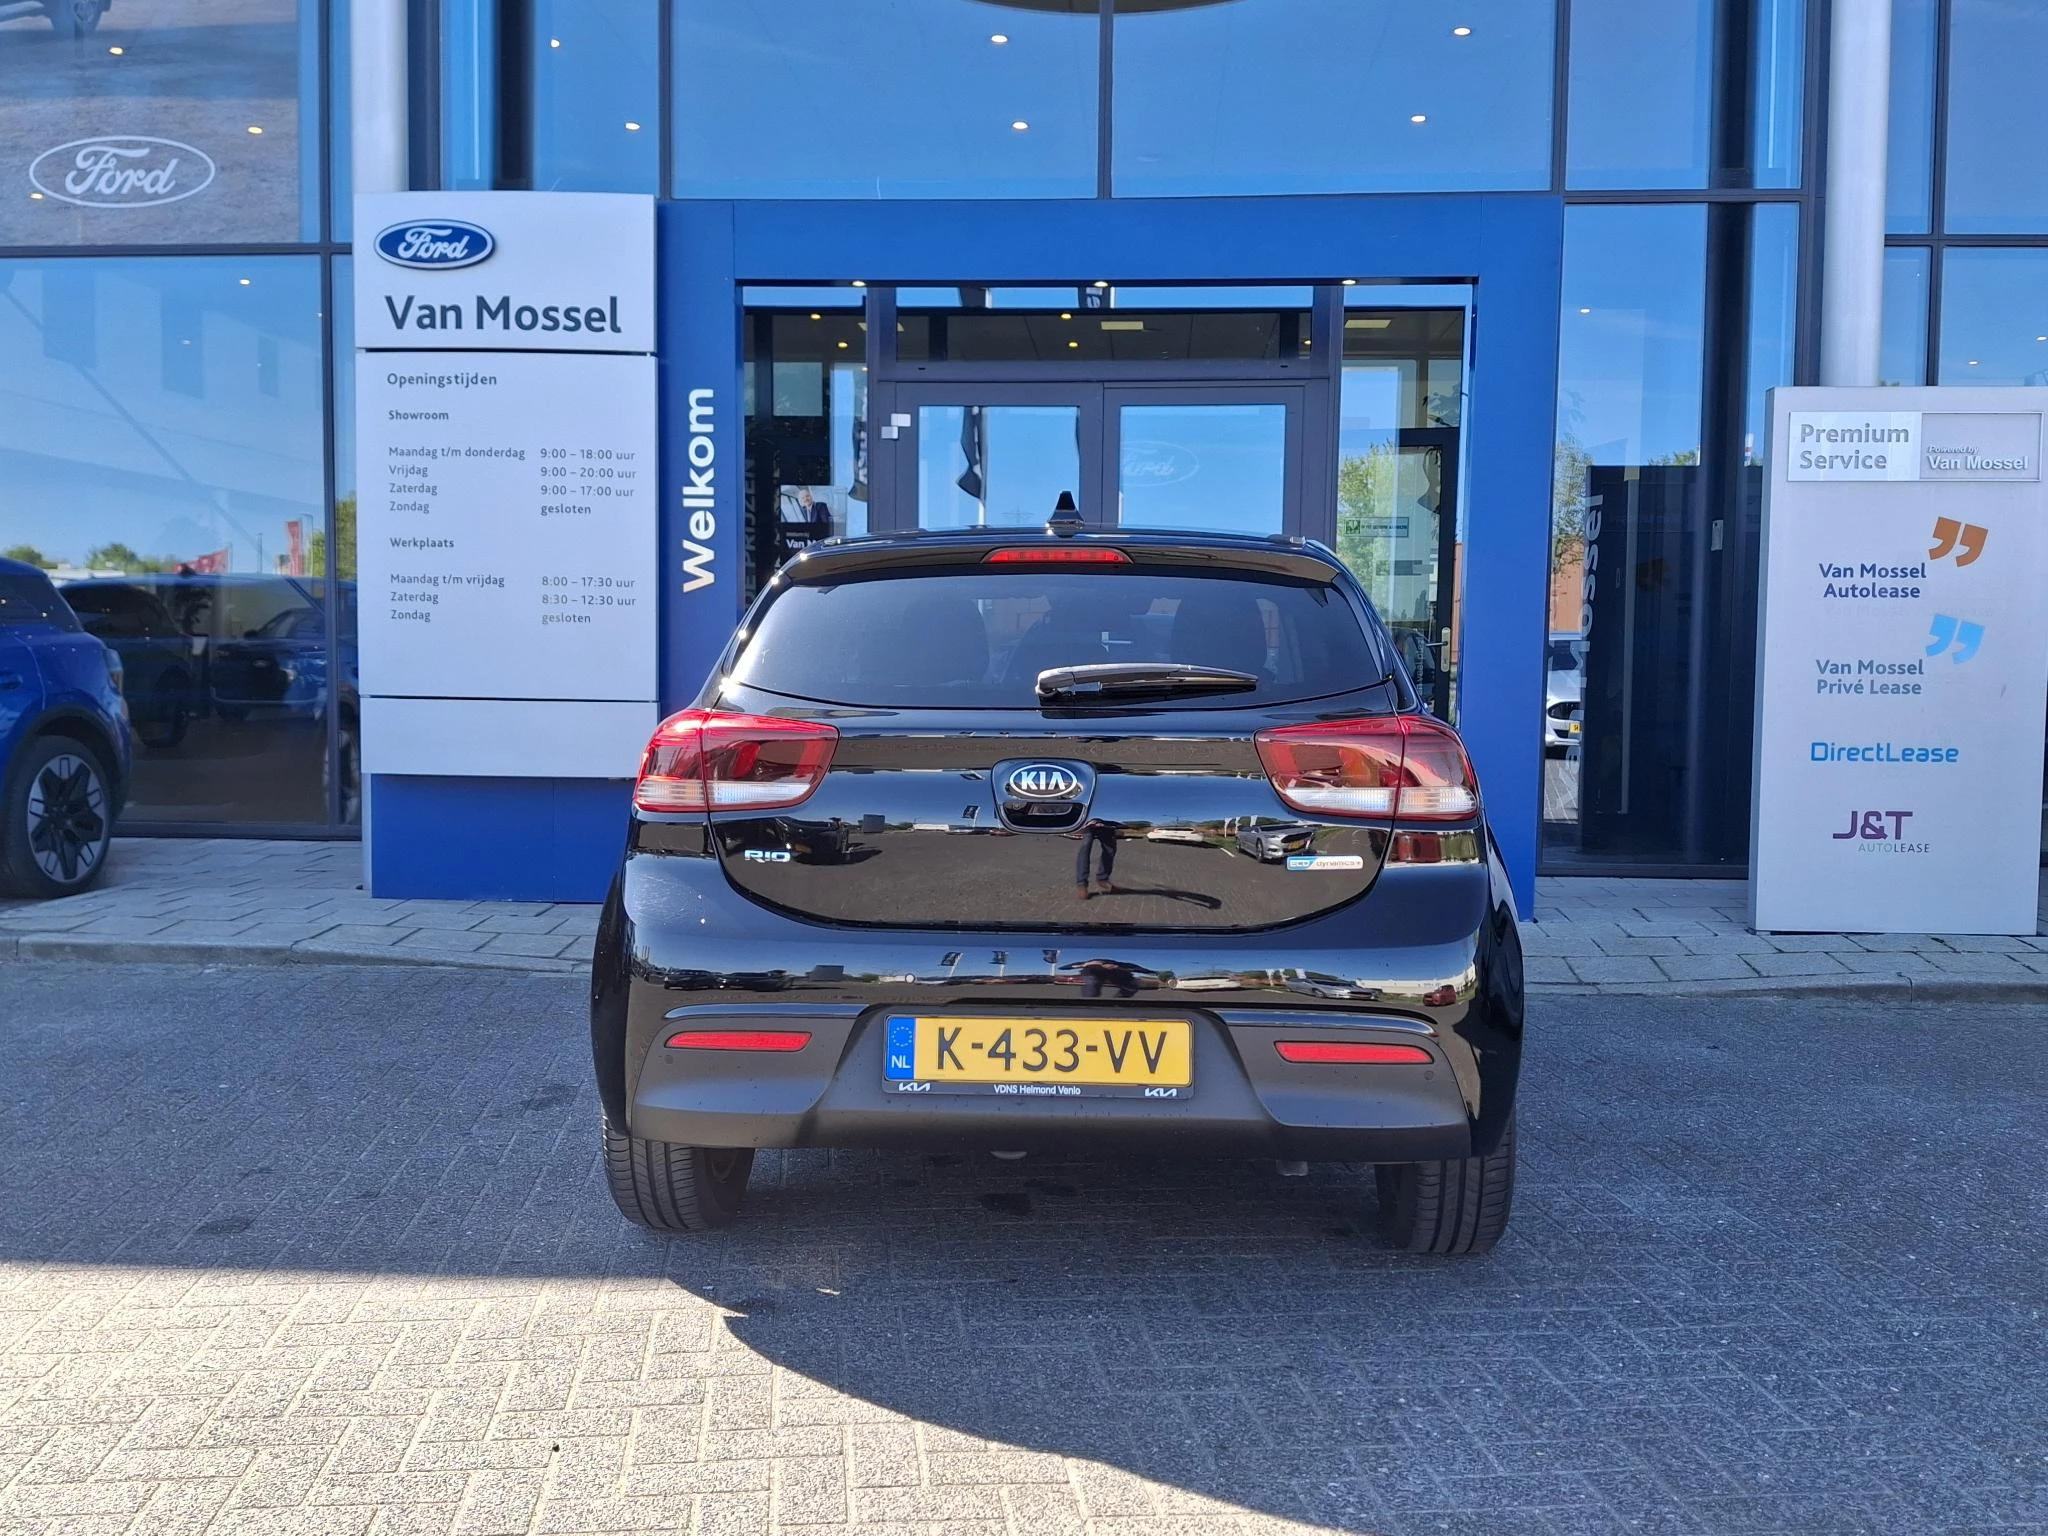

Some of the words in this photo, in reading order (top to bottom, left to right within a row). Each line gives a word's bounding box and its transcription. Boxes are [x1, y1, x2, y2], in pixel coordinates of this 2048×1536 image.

[65, 145, 180, 195] Ford
[398, 227, 470, 259] Ford
[385, 295, 462, 330] Van
[476, 295, 622, 333] Mossel
[387, 373, 497, 387] Openingstijden
[388, 409, 449, 421] Showroom
[1800, 423, 1909, 443] Premium
[388, 447, 438, 459] Maandag
[441, 448, 461, 457] t/m
[465, 447, 526, 460] donderdag
[540, 448, 567, 458] 9:00
[581, 449, 613, 460] 18:00
[616, 452, 636, 460] uur
[1800, 450, 1887, 469] Service
[1928, 455, 1960, 469] Van
[1966, 455, 2029, 470] Mossel
[388, 465, 429, 478] Vrijdag
[540, 466, 567, 477] 9:00
[580, 467, 614, 478] 20:00
[617, 470, 637, 478] uur
[389, 483, 438, 496] Zaterdag
[540, 485, 567, 495] 9:00
[581, 486, 612, 497] 17:00
[615, 488, 635, 497] uur
[683, 389, 715, 592] Welkom
[389, 501, 430, 514] Zondag
[540, 503, 592, 516] gesloten
[389, 537, 455, 550] Werkplaats
[1819, 563, 1854, 579] Van
[1860, 563, 1927, 579] Mossel
[390, 573, 440, 587] Maandag
[442, 574, 463, 584] t/m
[466, 575, 505, 588] vrijdag
[541, 576, 568, 586] 8:00
[582, 577, 613, 587] 17:30
[616, 580, 636, 588] uur
[1823, 582, 1921, 598] Autolease
[390, 591, 439, 605] Zaterdag
[541, 594, 568, 605] 8:30
[582, 595, 614, 606] 12:30
[617, 598, 637, 606] uur
[391, 609, 431, 623] Zondag
[541, 612, 591, 625] gesloten
[1816, 659, 1851, 675] Van
[1857, 659, 1925, 675] Mossel
[1817, 679, 1865, 694] Privé
[1870, 680, 1922, 695] Lease
[1811, 742, 1959, 763] DirectLease
[1021, 771, 1066, 790] KIA
[1833, 811, 1913, 840] J&T
[1858, 843, 1931, 853] AUTOLEASE
[744, 849, 791, 863] RIO
[937, 1026, 1167, 1074] K-433-VV
[891, 1055, 911, 1069] NL
[994, 1084, 1018, 1094] VDNS
[1019, 1084, 1056, 1095] Helmond
[1057, 1086, 1081, 1096] Venlo
